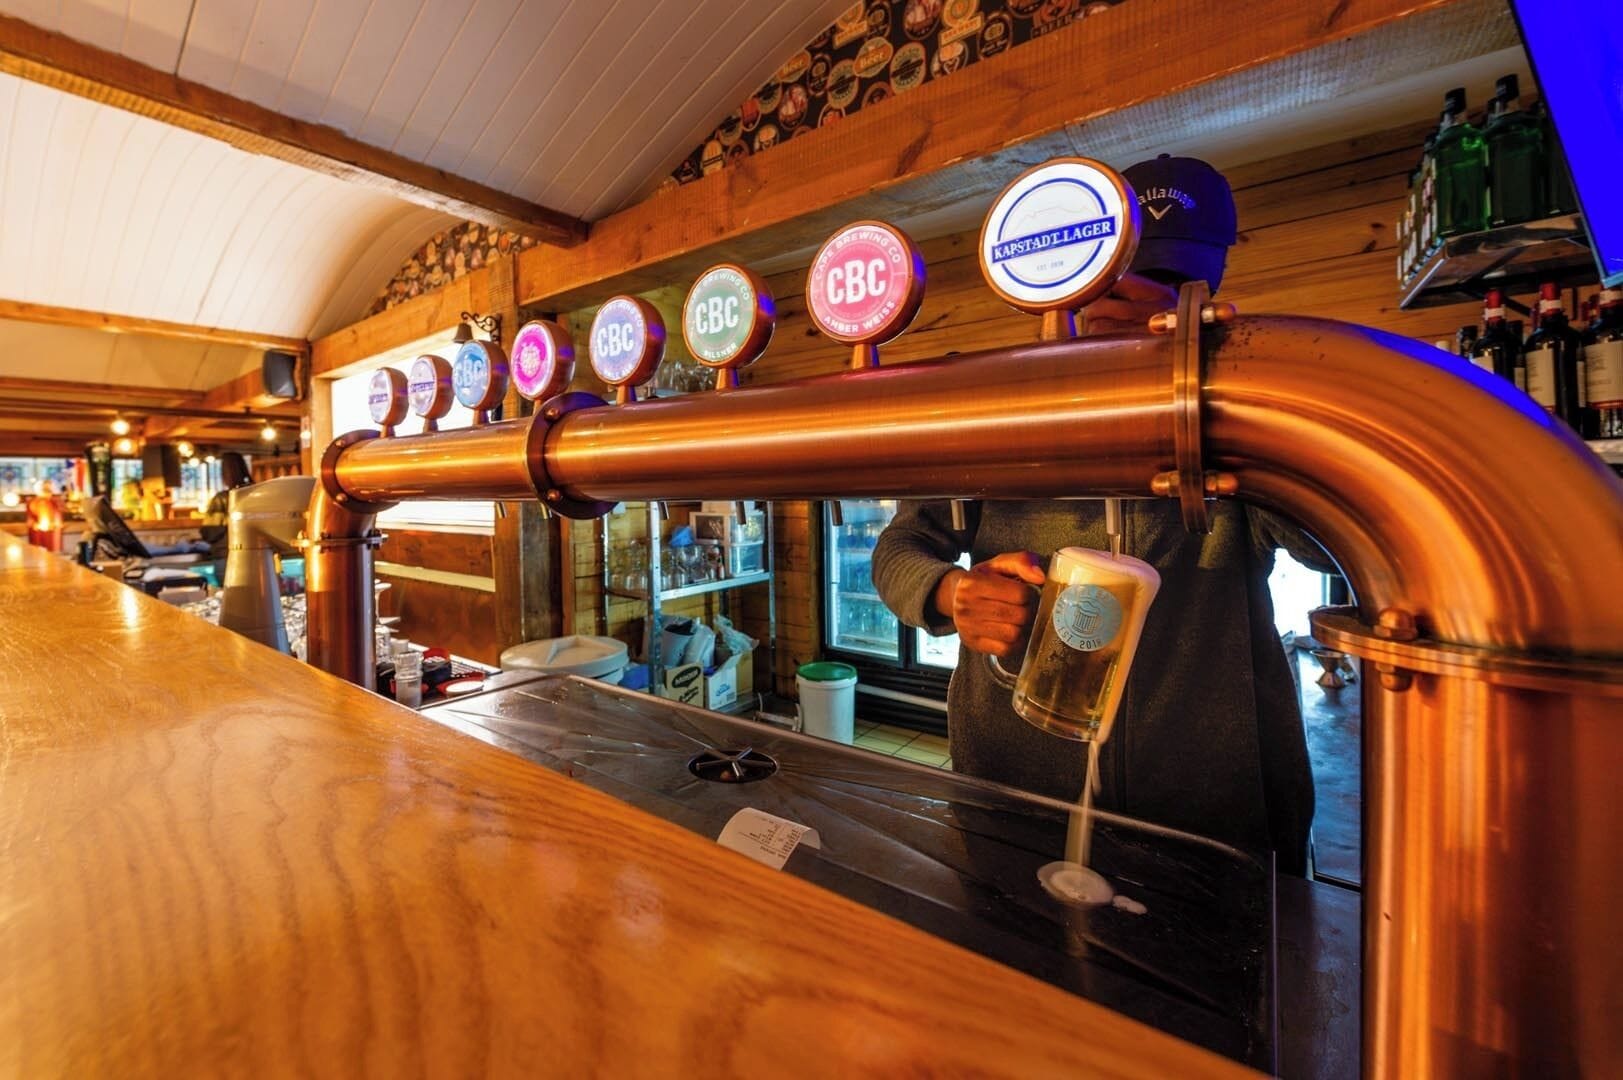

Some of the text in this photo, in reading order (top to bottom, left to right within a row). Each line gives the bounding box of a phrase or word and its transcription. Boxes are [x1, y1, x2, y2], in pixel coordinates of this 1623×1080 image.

[1136, 187, 1197, 209] allawa
[835, 231, 890, 249] BREWING
[888, 246, 901, 264] CO
[993, 220, 1112, 260] KAPSTADT LAGER
[827, 258, 887, 306] CBC
[695, 295, 740, 335] CBC
[823, 300, 895, 333] AMBER WEISS
[597, 322, 634, 358] CBC
